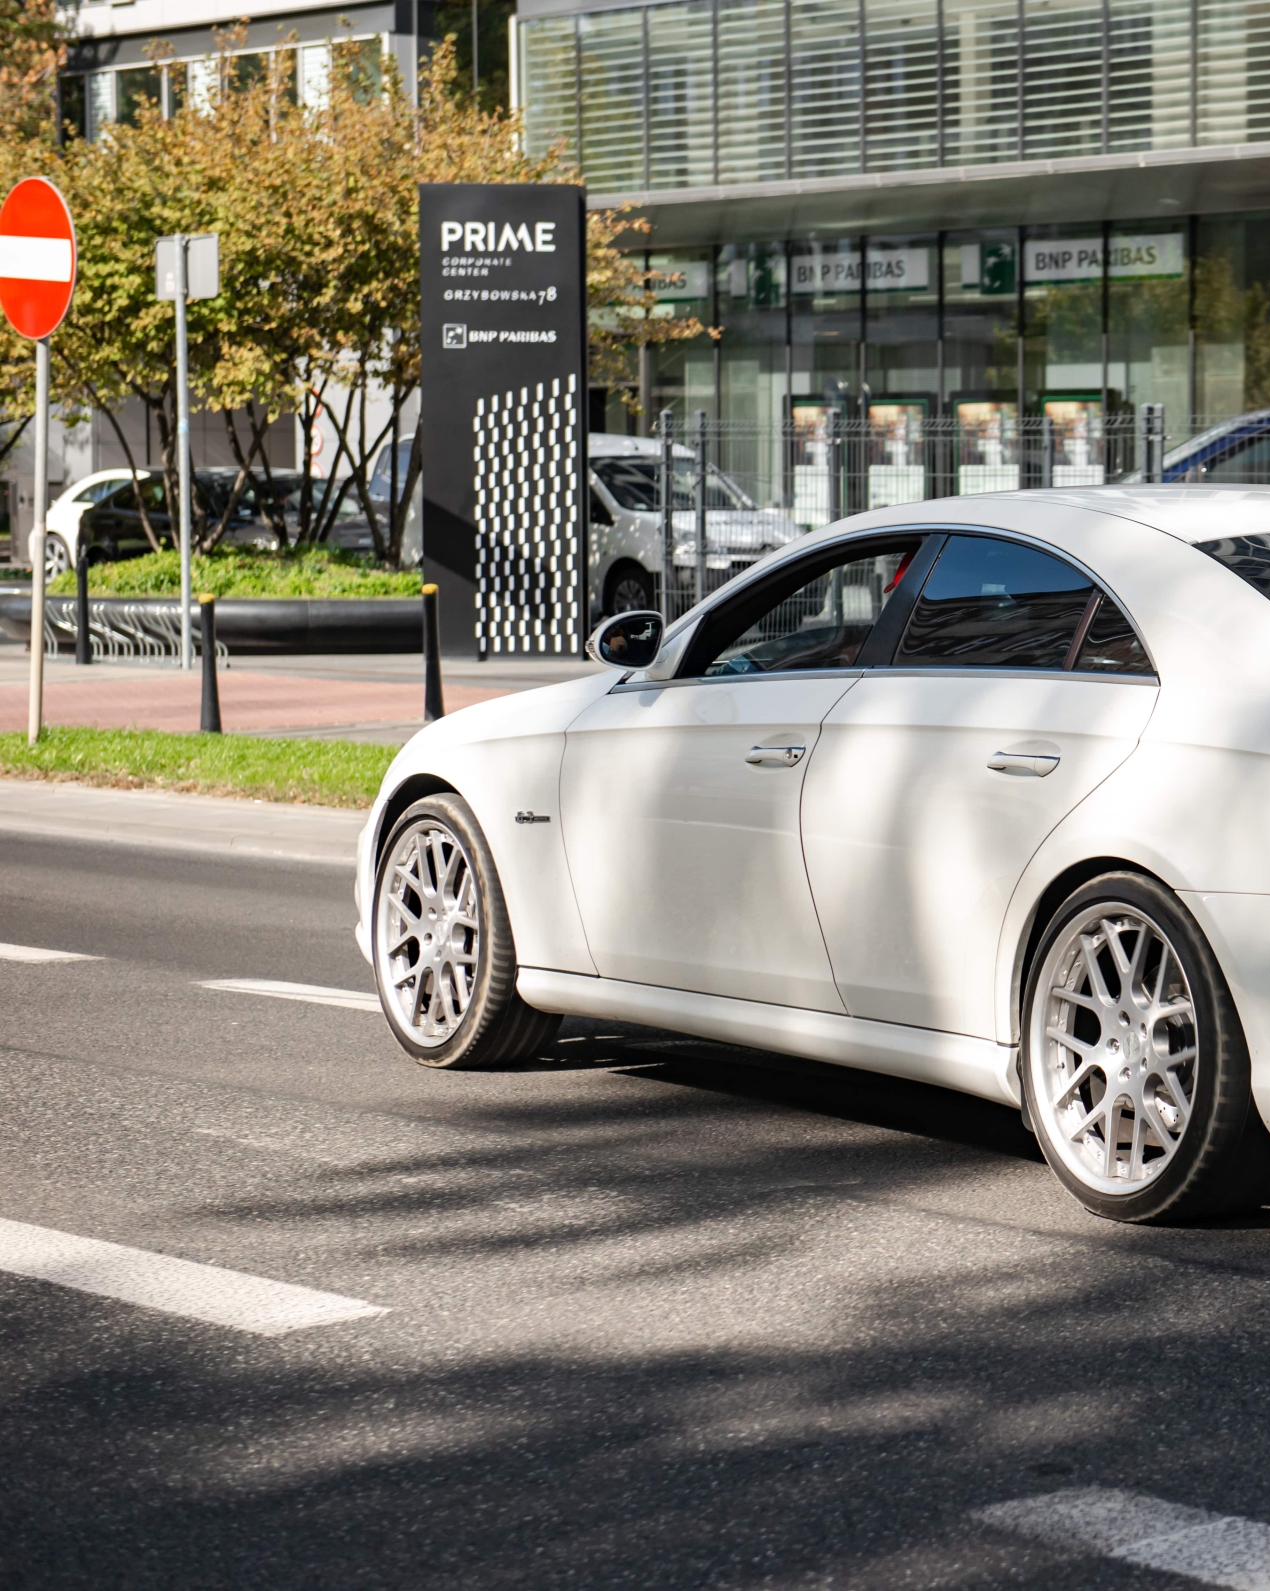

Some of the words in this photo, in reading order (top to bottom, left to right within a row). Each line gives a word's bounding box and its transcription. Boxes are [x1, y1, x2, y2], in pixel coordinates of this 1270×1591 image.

[441, 221, 556, 252] PRIME
[442, 257, 512, 267] CORPORATE
[1035, 251, 1073, 271] BNP
[442, 267, 489, 277] CENTER
[796, 263, 831, 283] BNP
[468, 330, 498, 343] BNP
[499, 330, 557, 343] PARIBAS
